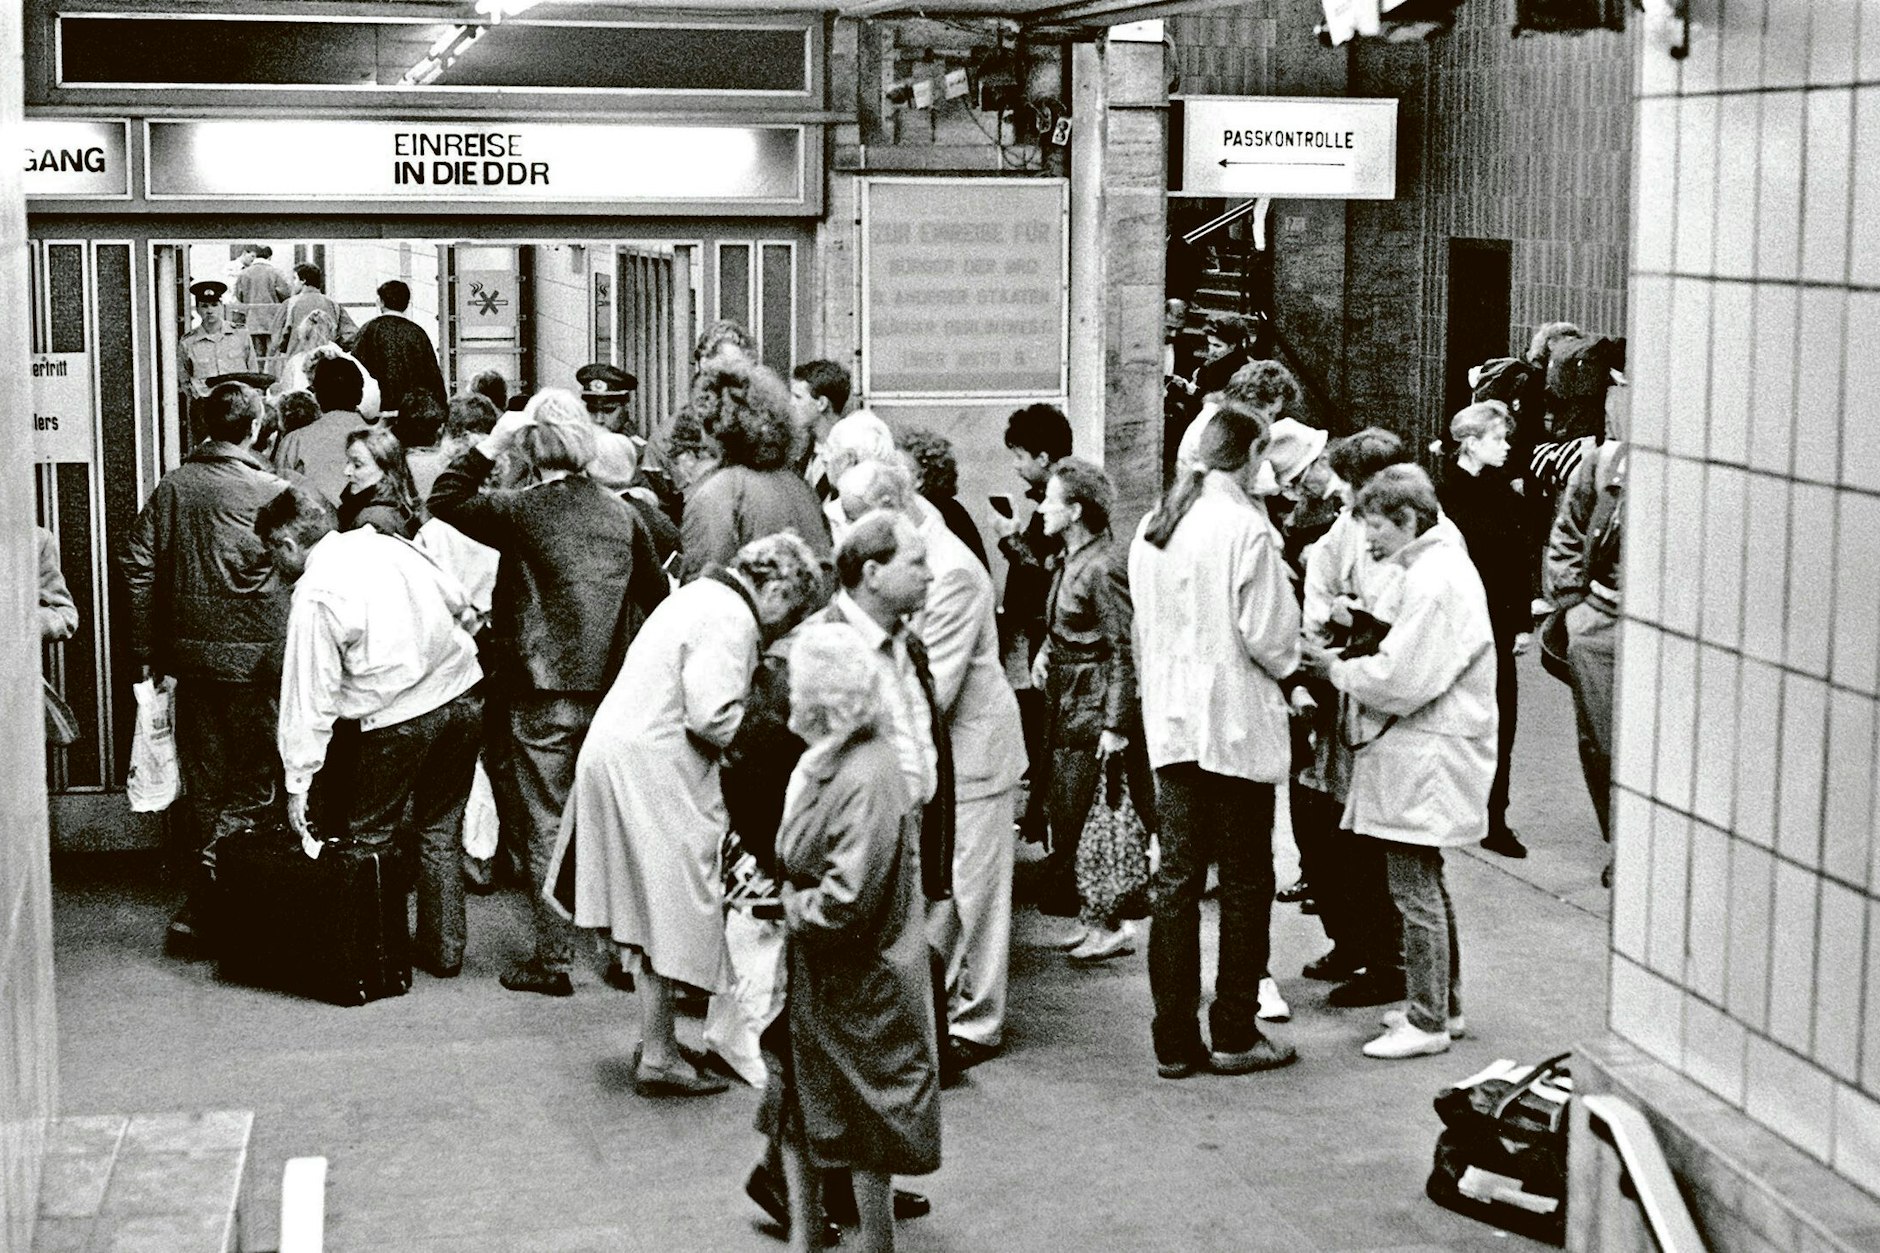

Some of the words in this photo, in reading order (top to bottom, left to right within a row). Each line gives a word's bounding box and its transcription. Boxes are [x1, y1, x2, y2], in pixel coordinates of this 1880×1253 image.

[395, 133, 522, 157] EINREISE
[1223, 130, 1354, 149] PASSKONTROLLE
[24, 147, 105, 173] GANG
[395, 161, 425, 184] IN
[433, 161, 477, 185] DIE
[483, 161, 549, 185] DDR
[33, 413, 59, 431] lers
